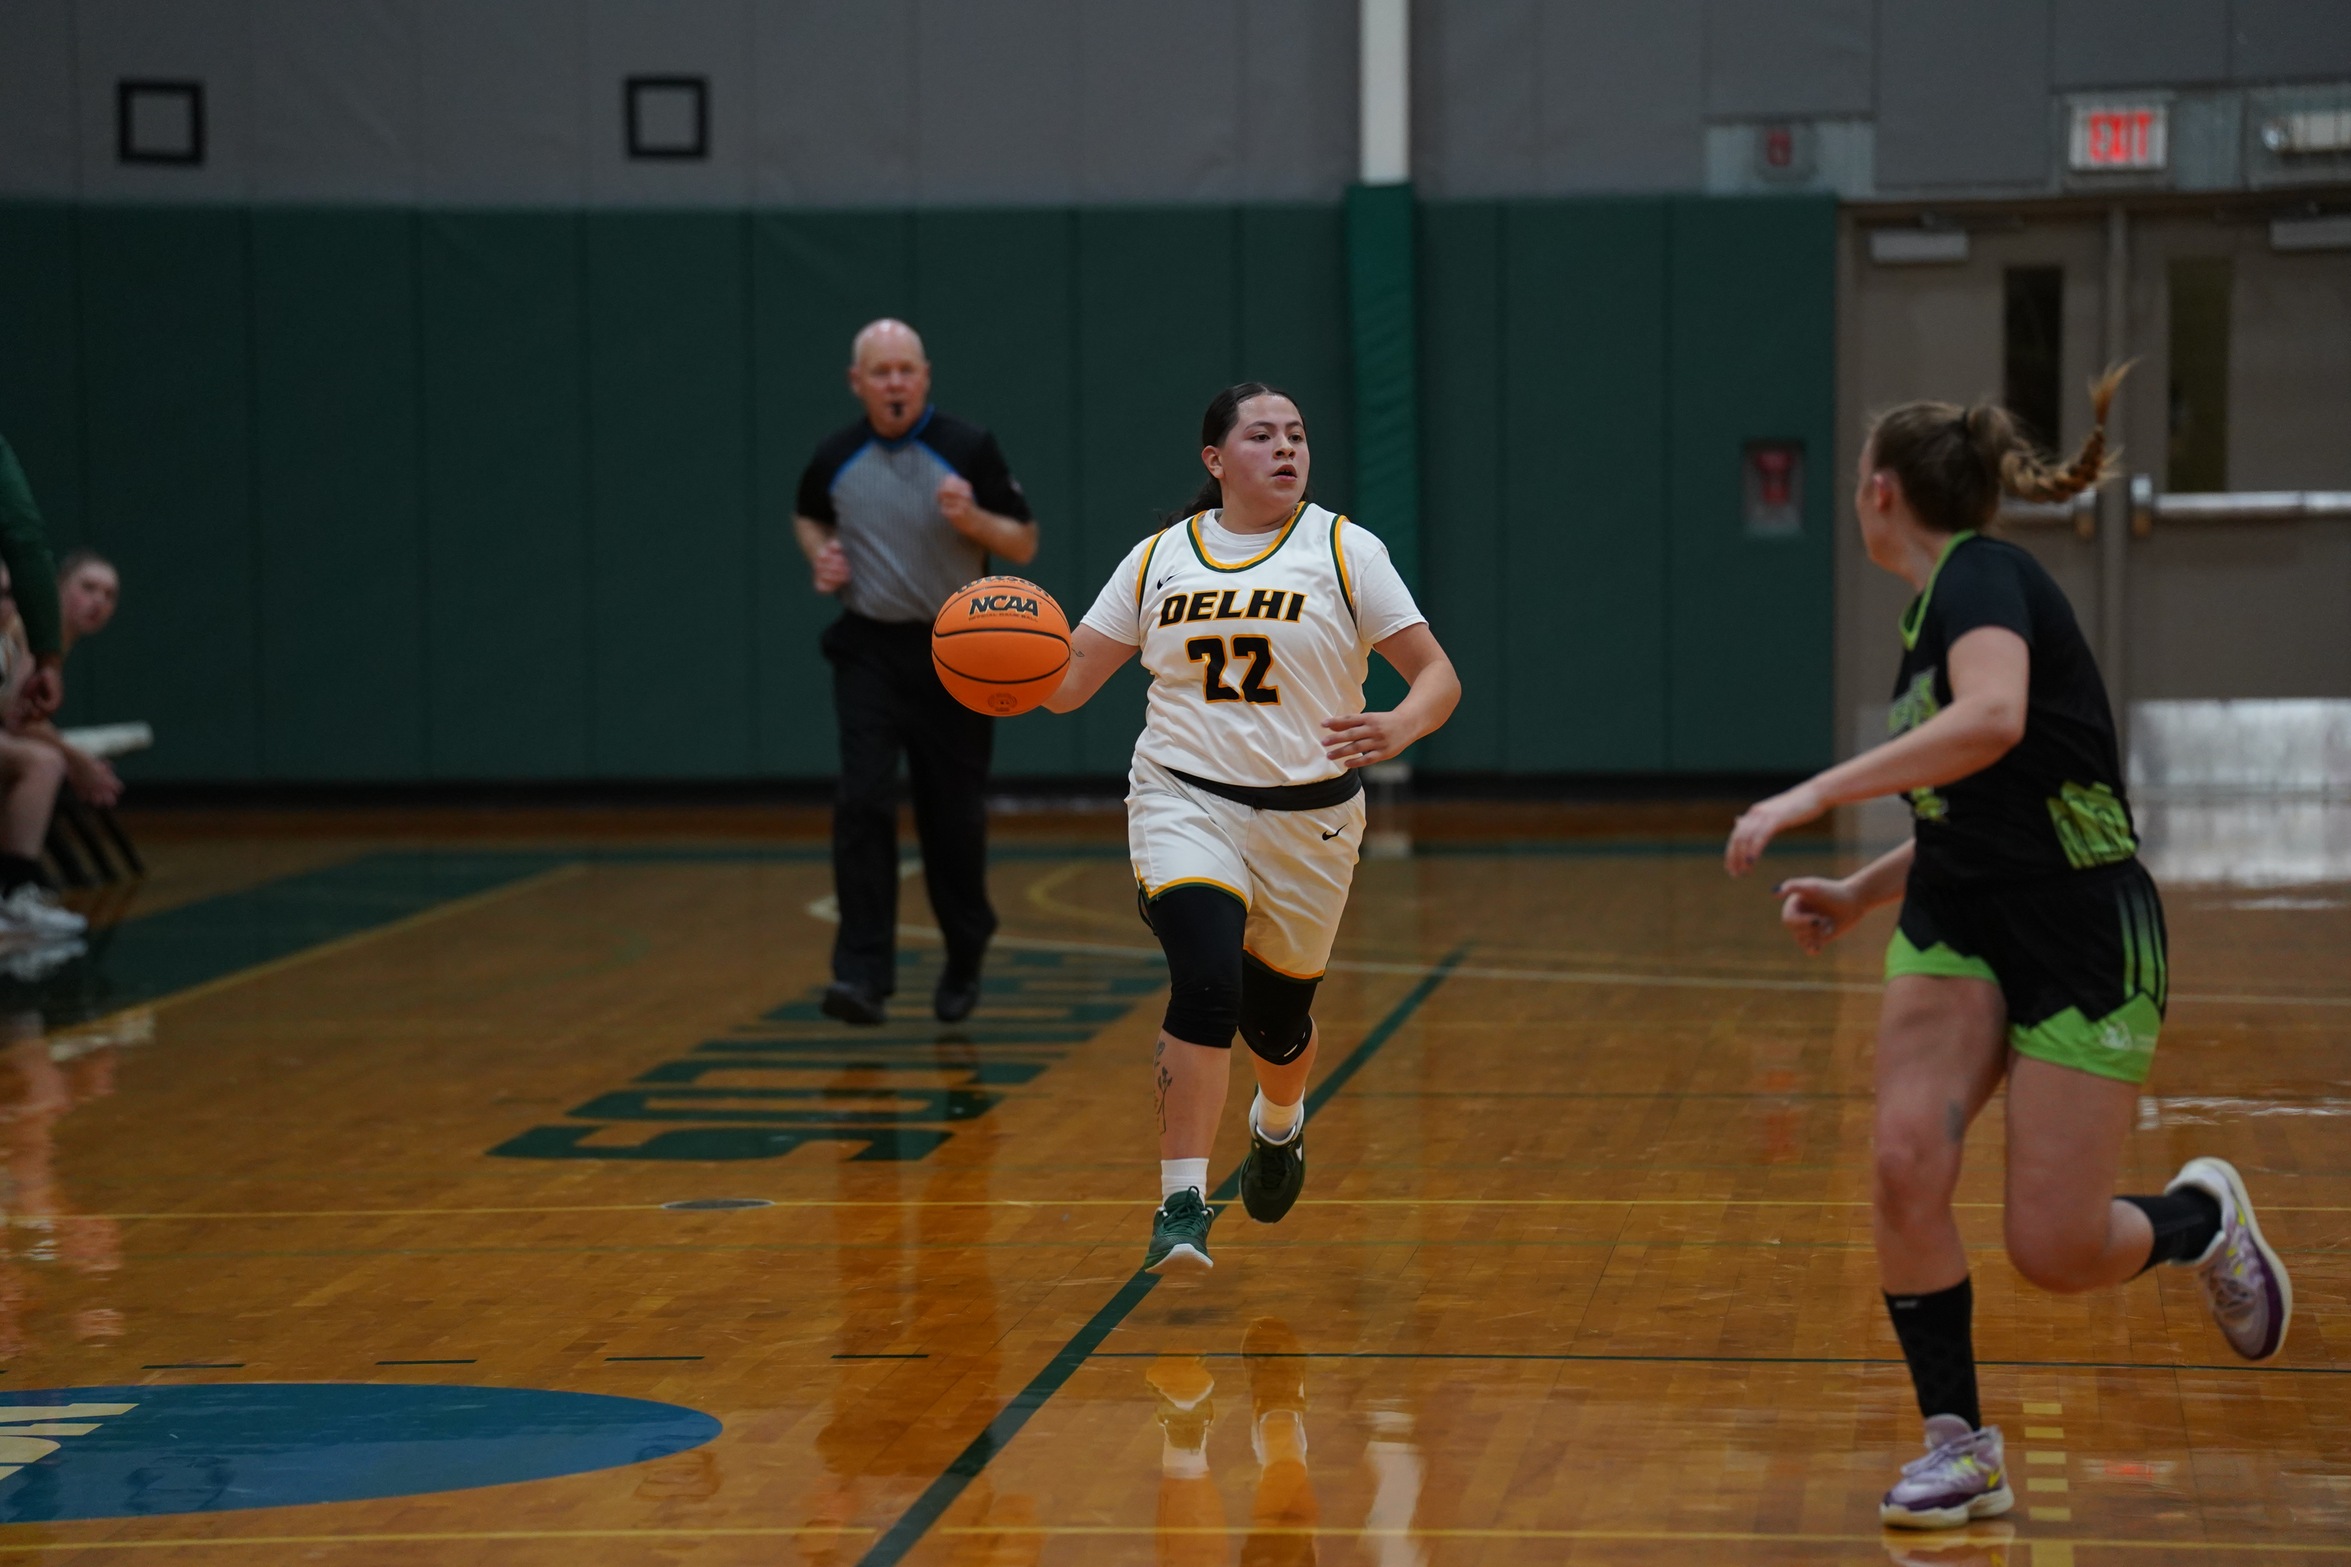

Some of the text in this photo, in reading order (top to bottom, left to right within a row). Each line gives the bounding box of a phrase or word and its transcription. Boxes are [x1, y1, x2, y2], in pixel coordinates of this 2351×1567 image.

[2088, 110, 2152, 163] EXIT
[969, 595, 1039, 617] NCAA
[1158, 588, 1308, 629] DELHI
[1185, 634, 1281, 706] 22
